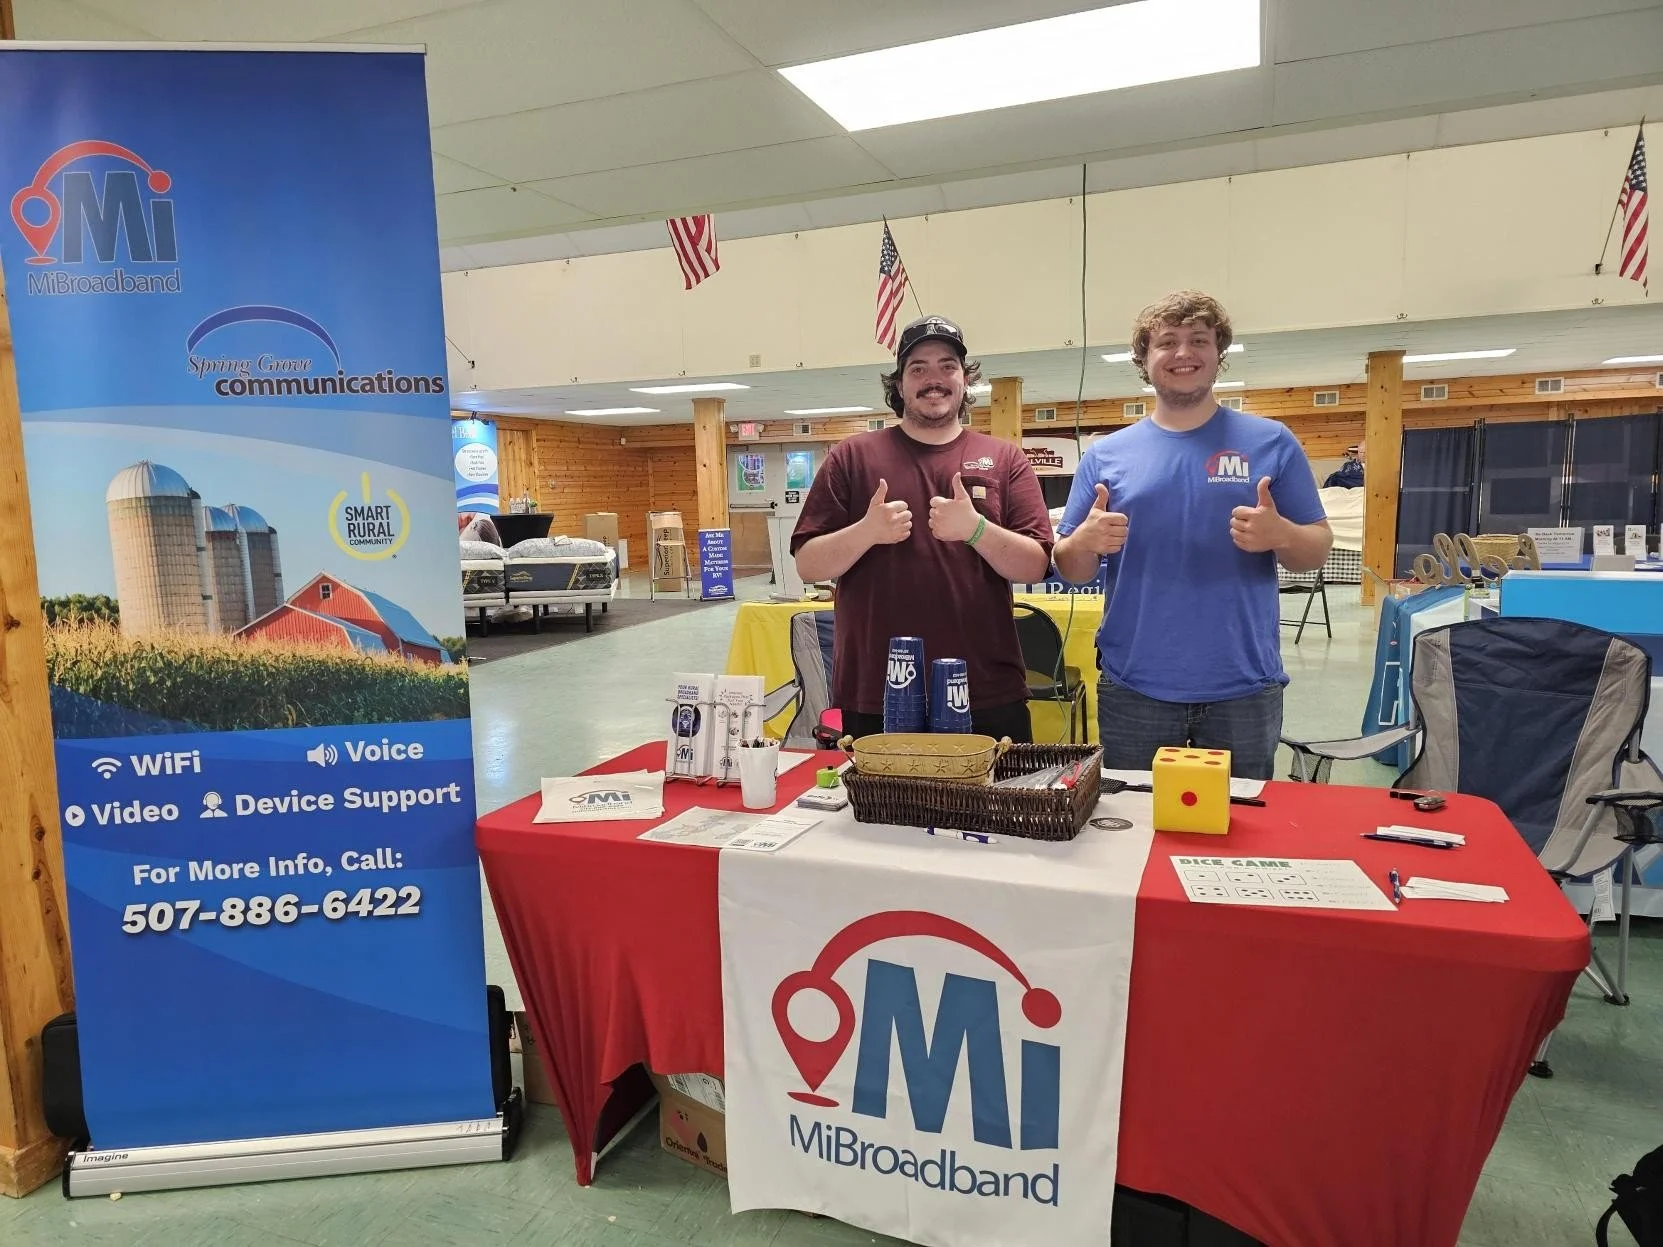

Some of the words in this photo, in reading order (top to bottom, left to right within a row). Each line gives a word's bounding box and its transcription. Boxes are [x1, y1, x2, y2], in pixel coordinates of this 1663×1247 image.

[63, 170, 178, 263] Mi
[28, 268, 182, 296] MiBroadband
[187, 355, 250, 379] Spring
[257, 353, 313, 373] Grove
[215, 369, 445, 397] communications
[1030, 458, 1061, 466] LVILLE
[1217, 455, 1249, 477] Mi
[345, 505, 391, 521] SMART
[347, 521, 395, 538] RURAL
[350, 538, 393, 546] COMMUNITY
[130, 750, 201, 777] WiFi
[344, 738, 424, 763] Voice
[236, 788, 335, 816] Device
[343, 782, 461, 813] Support
[92, 801, 179, 826] Video
[133, 864, 179, 885] For
[189, 859, 260, 882] More
[269, 852, 333, 877] Info,
[341, 848, 403, 871] Call:
[1179, 858, 1224, 866] DICE
[1231, 859, 1292, 868] GAME
[121, 885, 422, 934] 507-886-6422
[851, 957, 1062, 1151] Mi
[83, 1153, 128, 1162] Imagine
[789, 1114, 1060, 1207] MiBroadband
